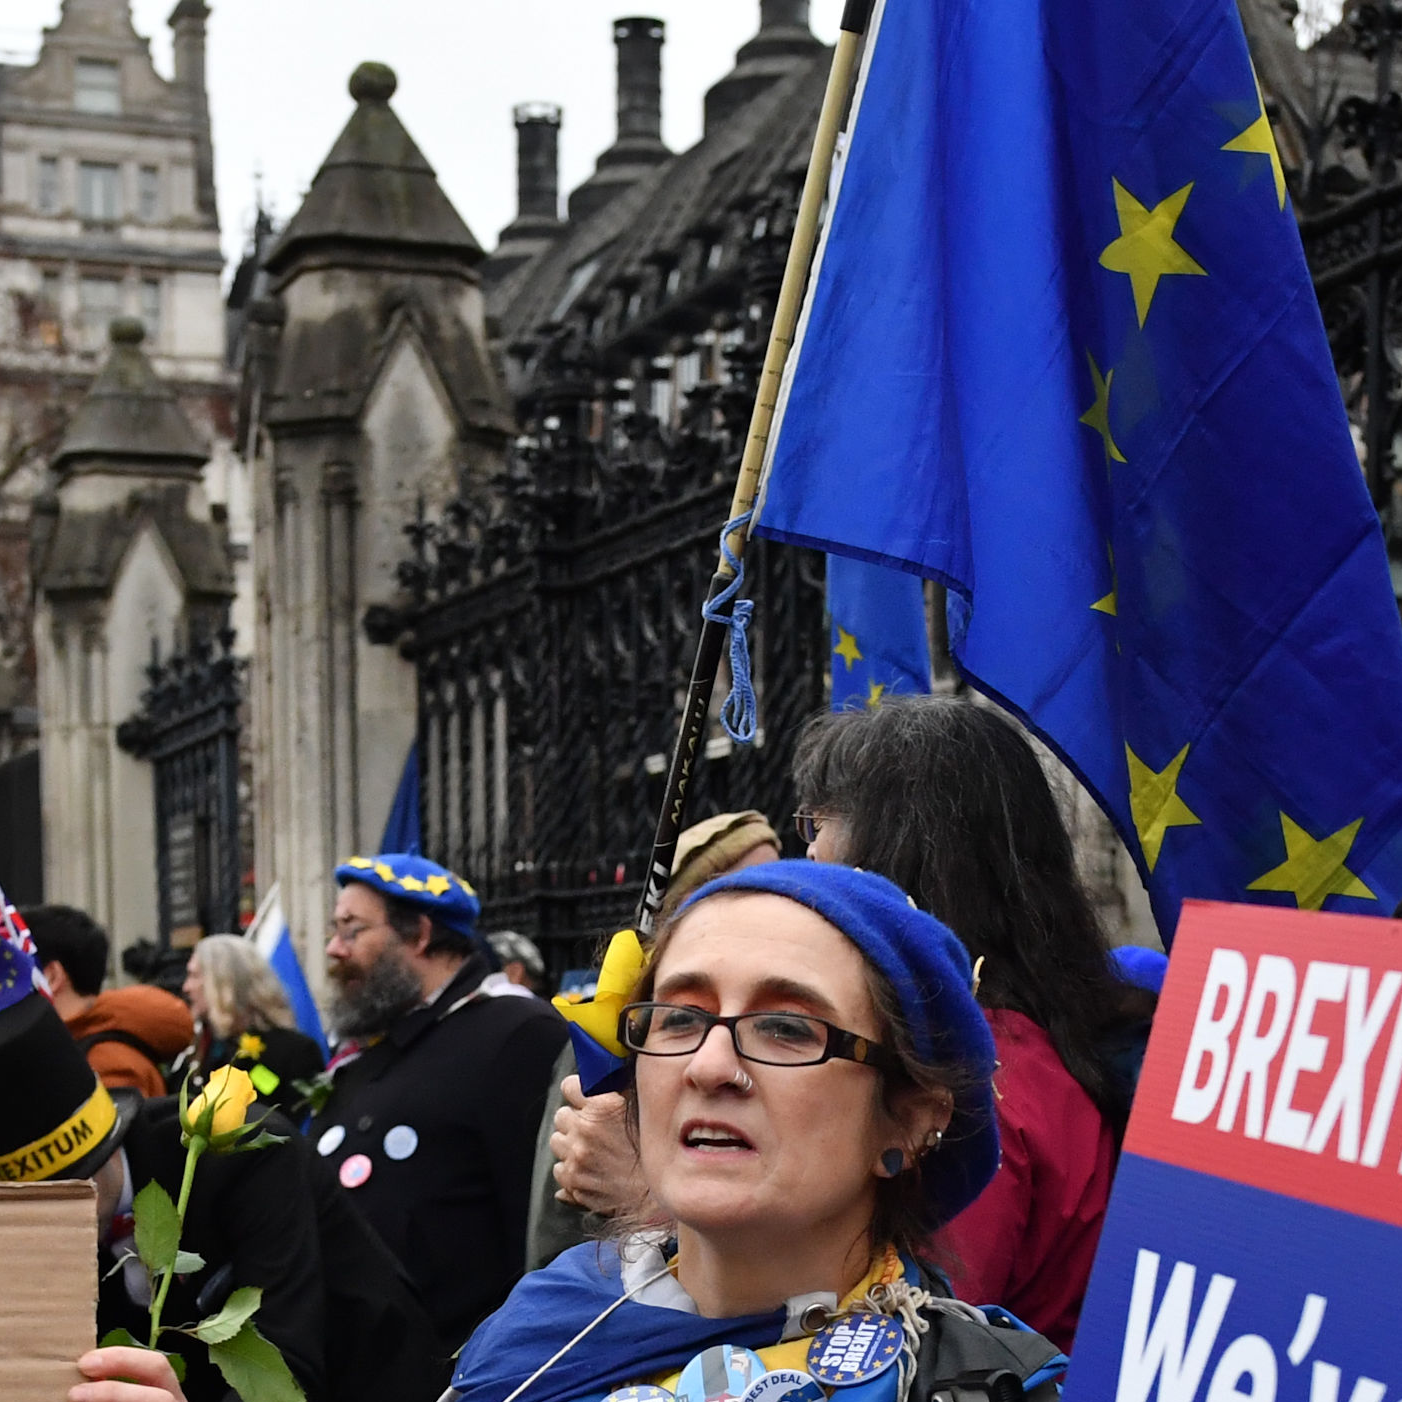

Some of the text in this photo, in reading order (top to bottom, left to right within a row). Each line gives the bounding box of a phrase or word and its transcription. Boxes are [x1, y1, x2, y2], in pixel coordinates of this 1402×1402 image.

[819, 1325, 855, 1367] STOP
[838, 1321, 878, 1372] BREXIT
[771, 1373, 802, 1385] DEAL
